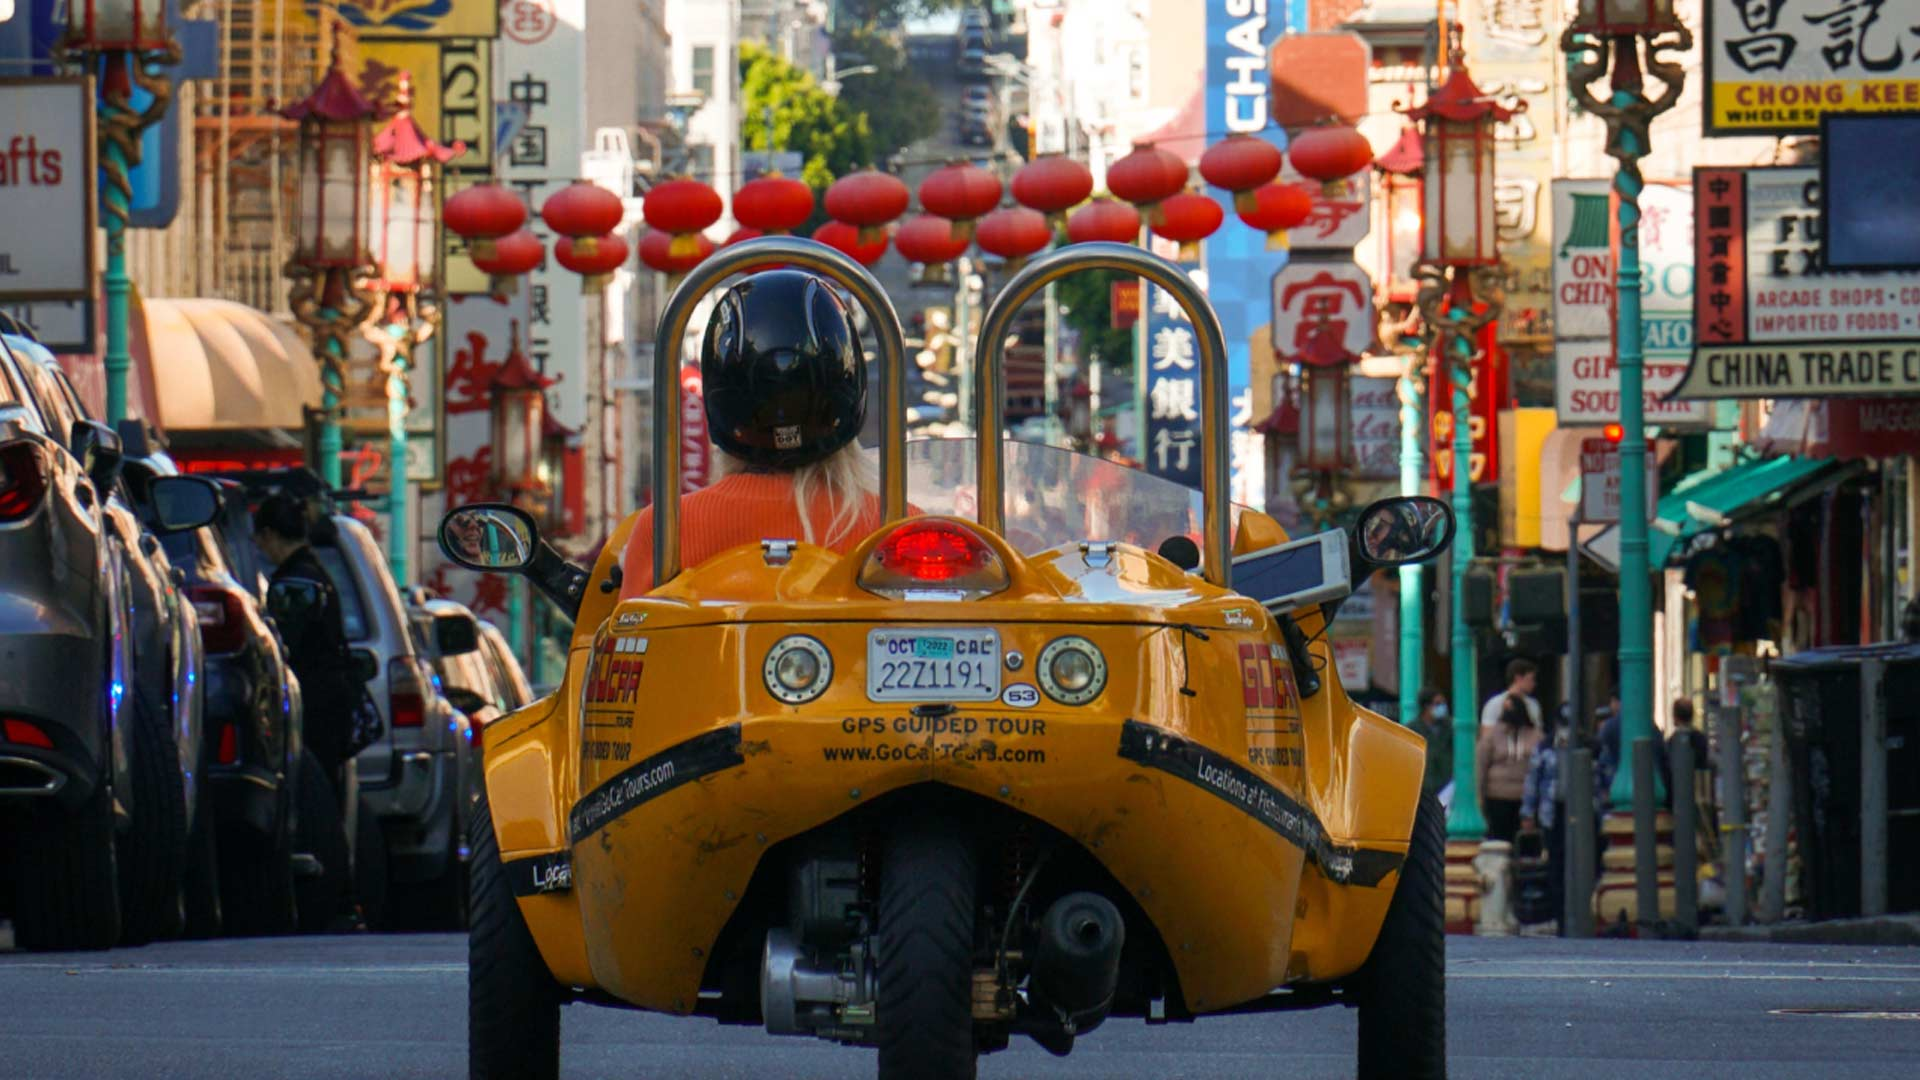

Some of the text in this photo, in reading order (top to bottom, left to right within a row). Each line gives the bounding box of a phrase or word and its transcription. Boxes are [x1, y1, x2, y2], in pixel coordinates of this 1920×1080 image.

[1725, 0, 1920, 73] 昌記
[1736, 84, 1844, 106] CHONG
[1756, 290, 1821, 308] ARCADE
[1830, 288, 1884, 306] SHOPS
[1756, 314, 1838, 332] IMPORTED
[1846, 312, 1899, 331] FOODS
[1707, 352, 1792, 386] CHINA
[1799, 351, 1893, 384] TRADE
[889, 639, 917, 655] OCT
[926, 641, 948, 651] 2022
[956, 639, 993, 655] CAL
[881, 661, 988, 689] 22Z1191
[1008, 690, 1036, 702] 53
[842, 717, 1046, 736] GPS GUIDED TOUR
[1197, 755, 1247, 801] Locations
